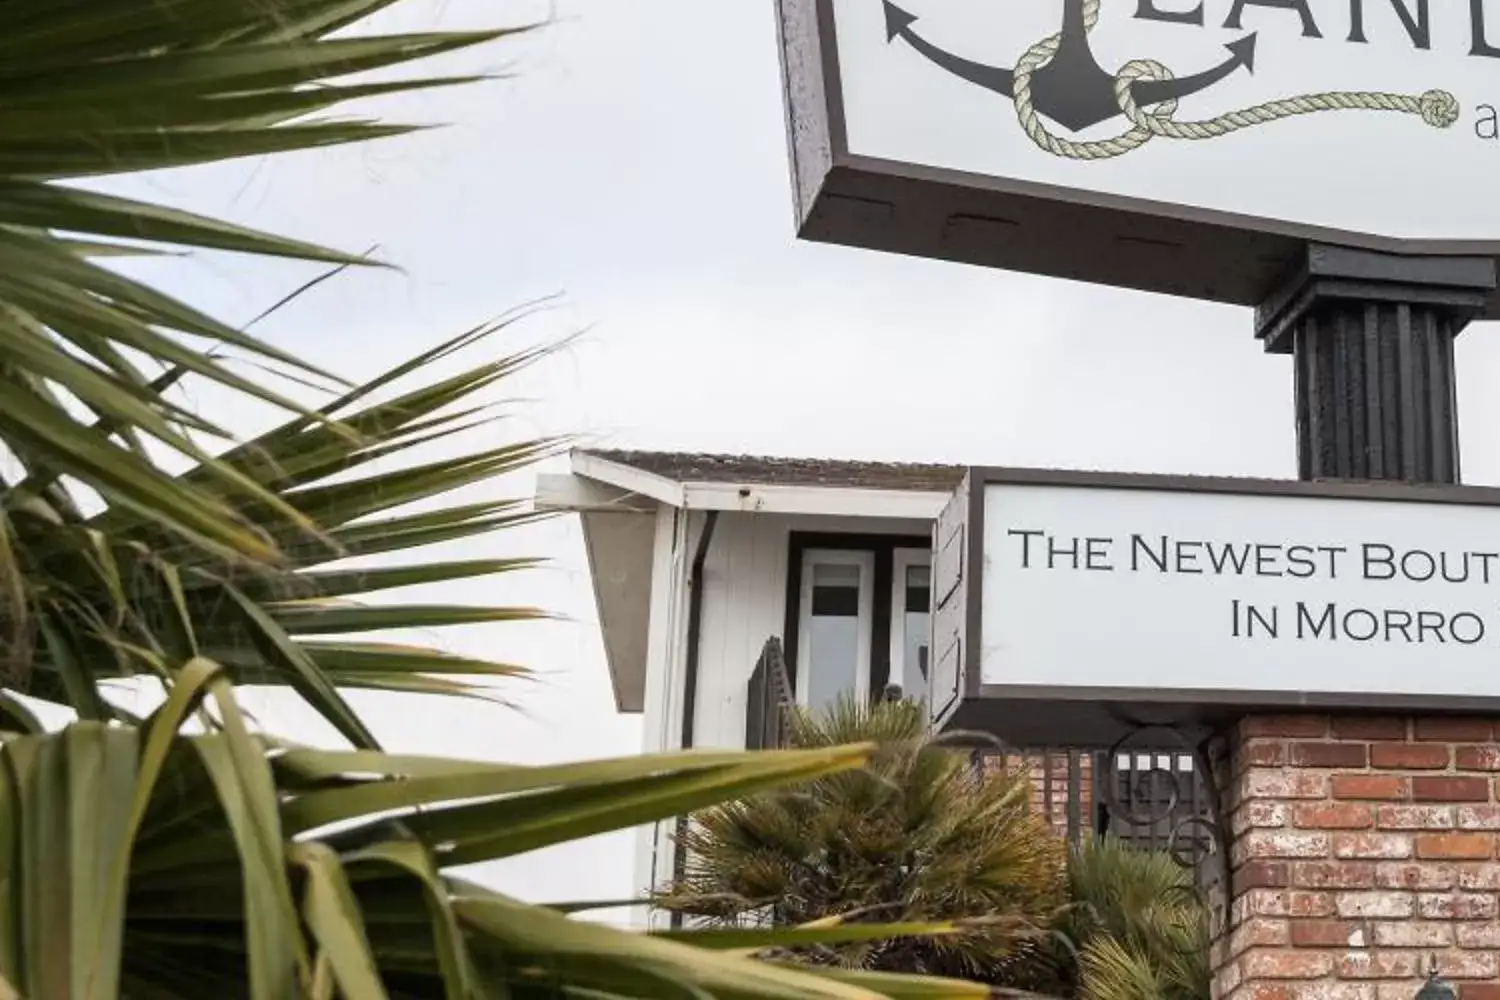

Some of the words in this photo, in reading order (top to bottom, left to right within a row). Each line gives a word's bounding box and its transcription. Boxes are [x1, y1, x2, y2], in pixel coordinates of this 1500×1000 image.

[1007, 528, 1114, 571] THE
[1130, 533, 1347, 579] NEWEST
[1231, 599, 1279, 639] IN
[1295, 601, 1485, 646] MORRO
